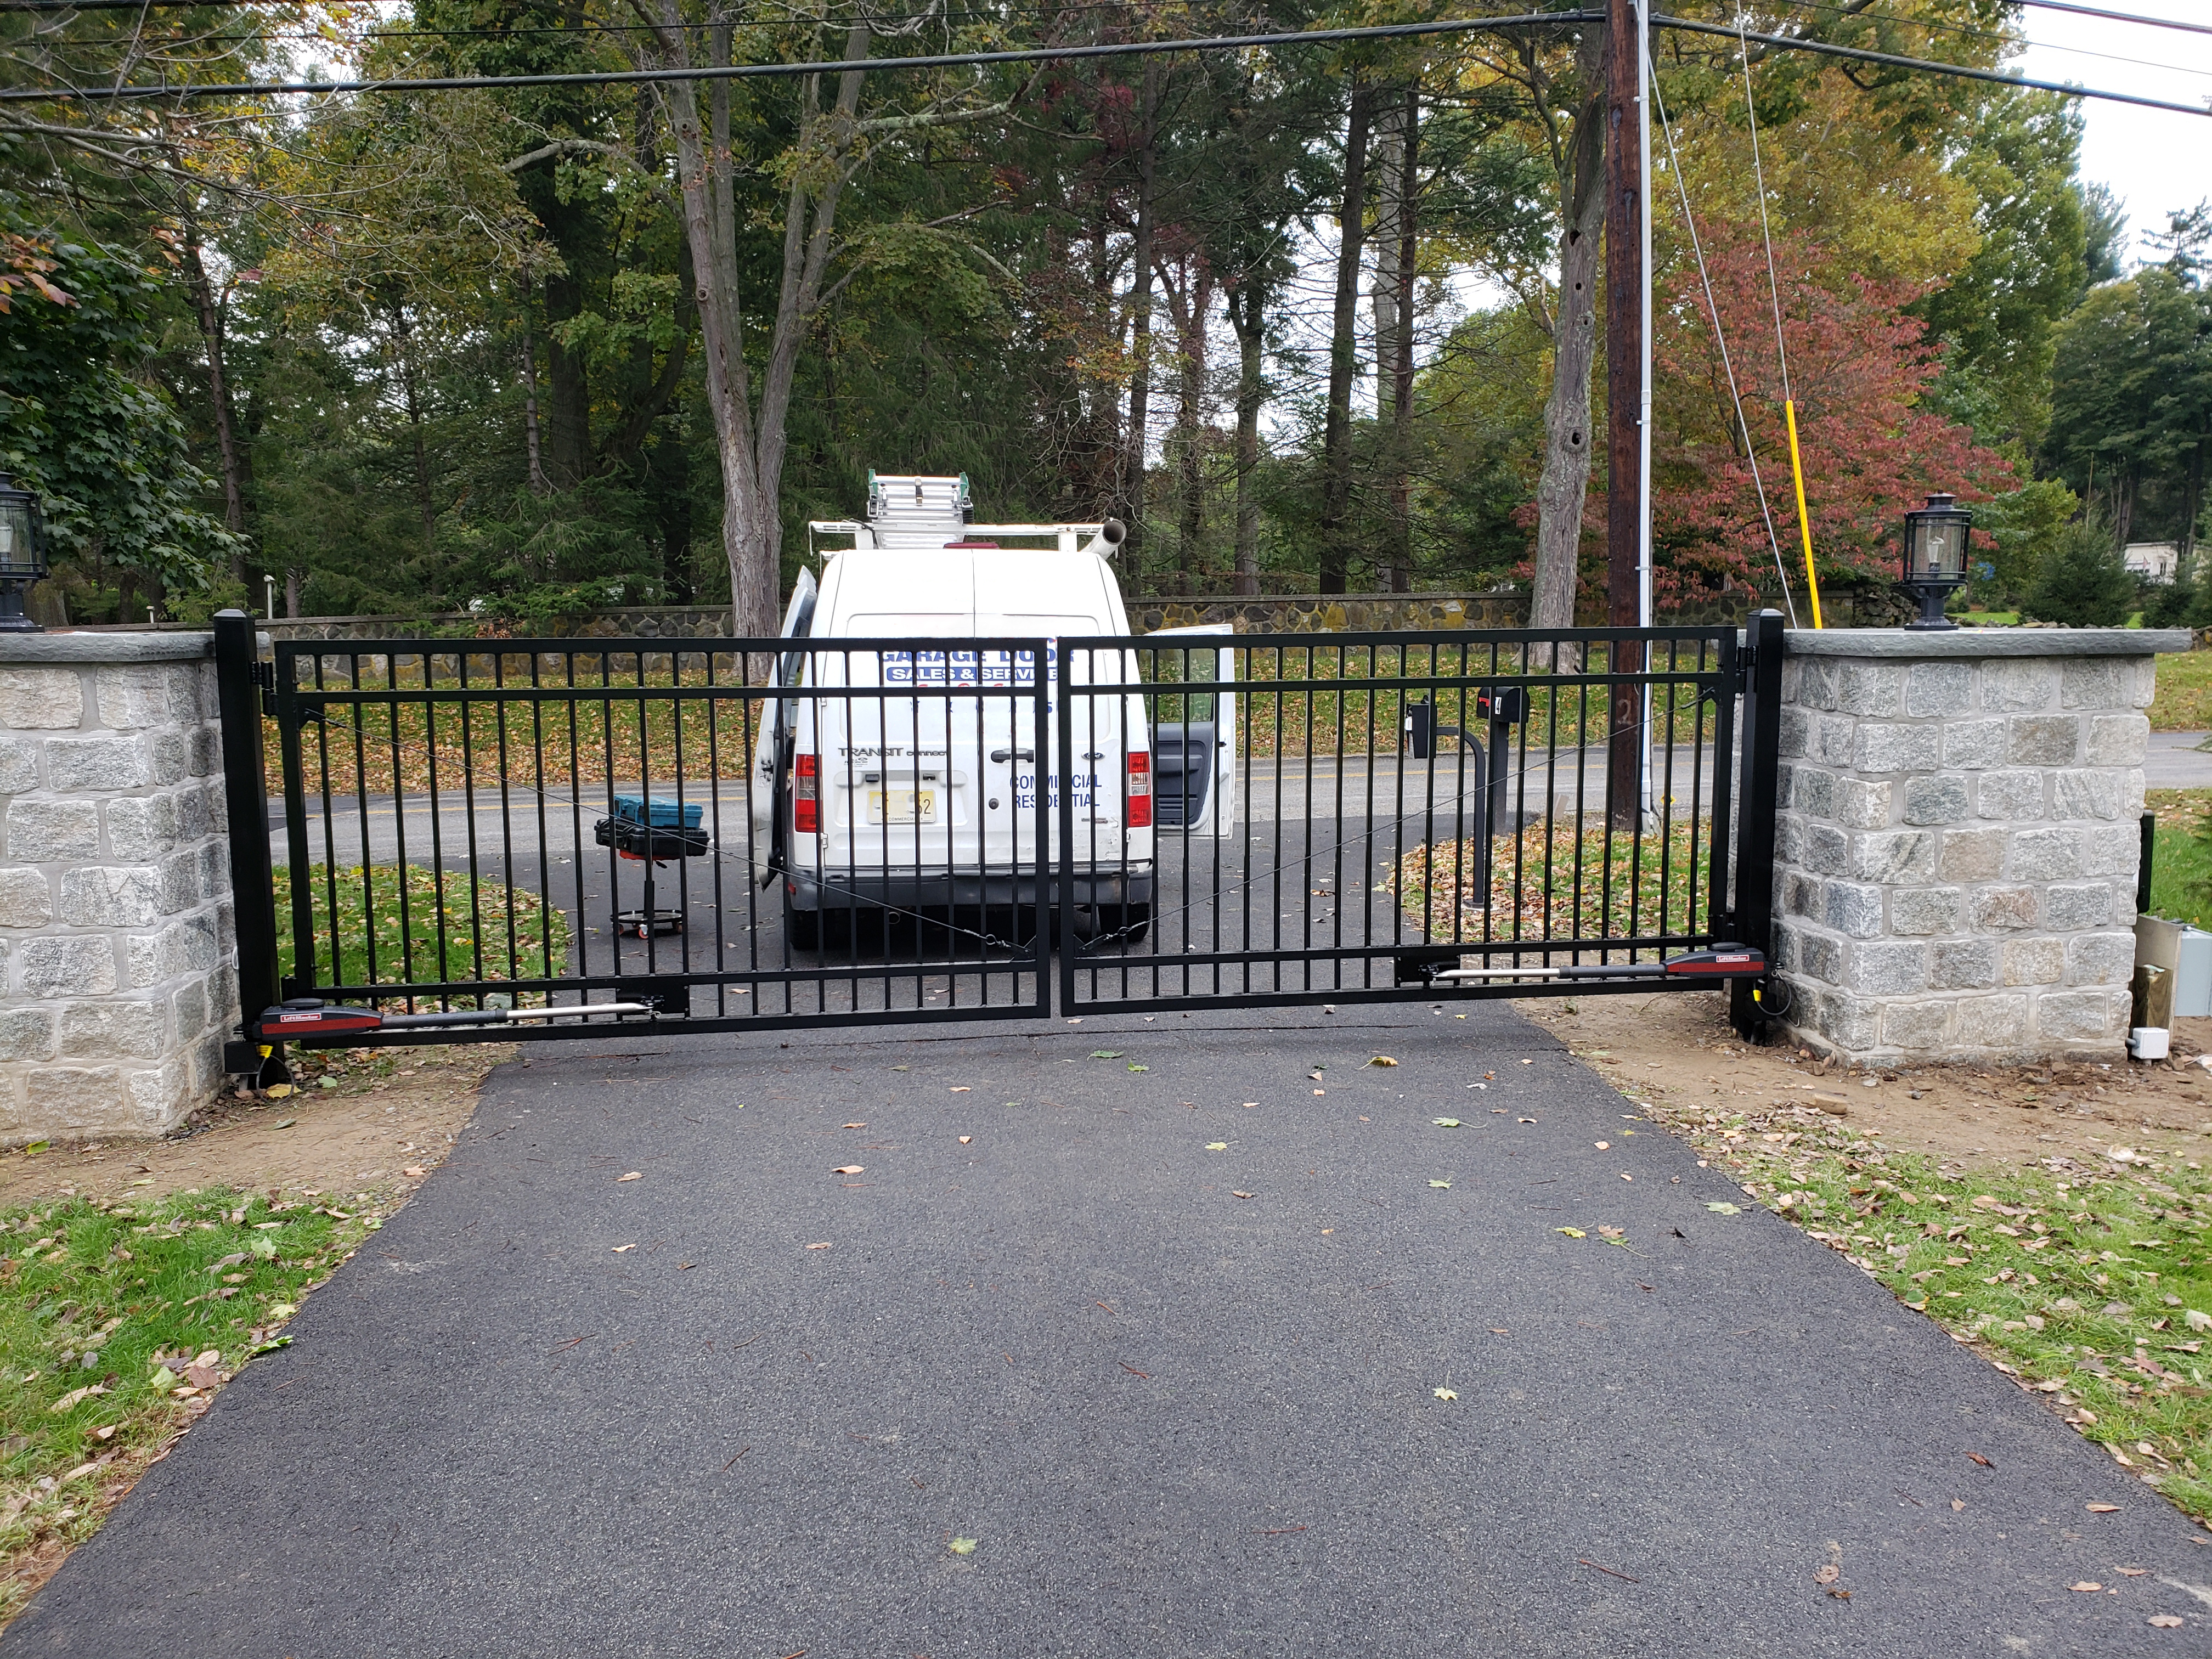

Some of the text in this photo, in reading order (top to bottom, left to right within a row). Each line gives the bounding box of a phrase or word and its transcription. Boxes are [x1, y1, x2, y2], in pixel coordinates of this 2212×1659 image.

[892, 669, 956, 680] SALES
[960, 669, 975, 680] &
[838, 747, 904, 757] TRANSIT
